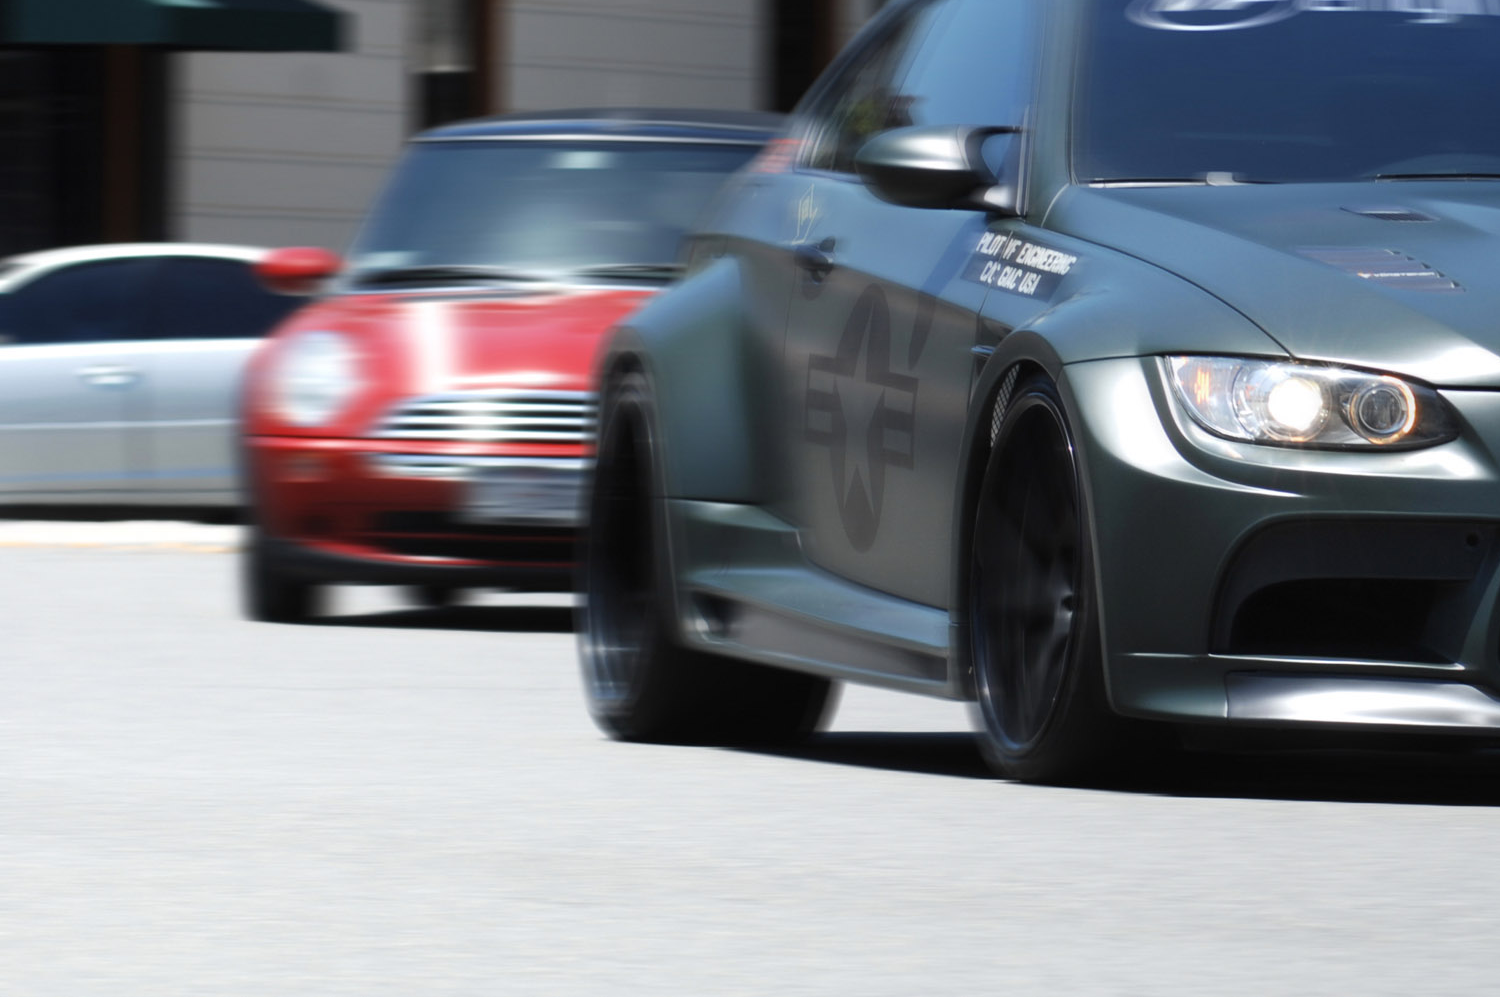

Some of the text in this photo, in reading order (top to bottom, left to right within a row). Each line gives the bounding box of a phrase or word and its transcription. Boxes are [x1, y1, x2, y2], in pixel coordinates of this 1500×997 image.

[976, 231, 1078, 276] PILOT VF ENGINEERING
[1018, 271, 1042, 296] USA
